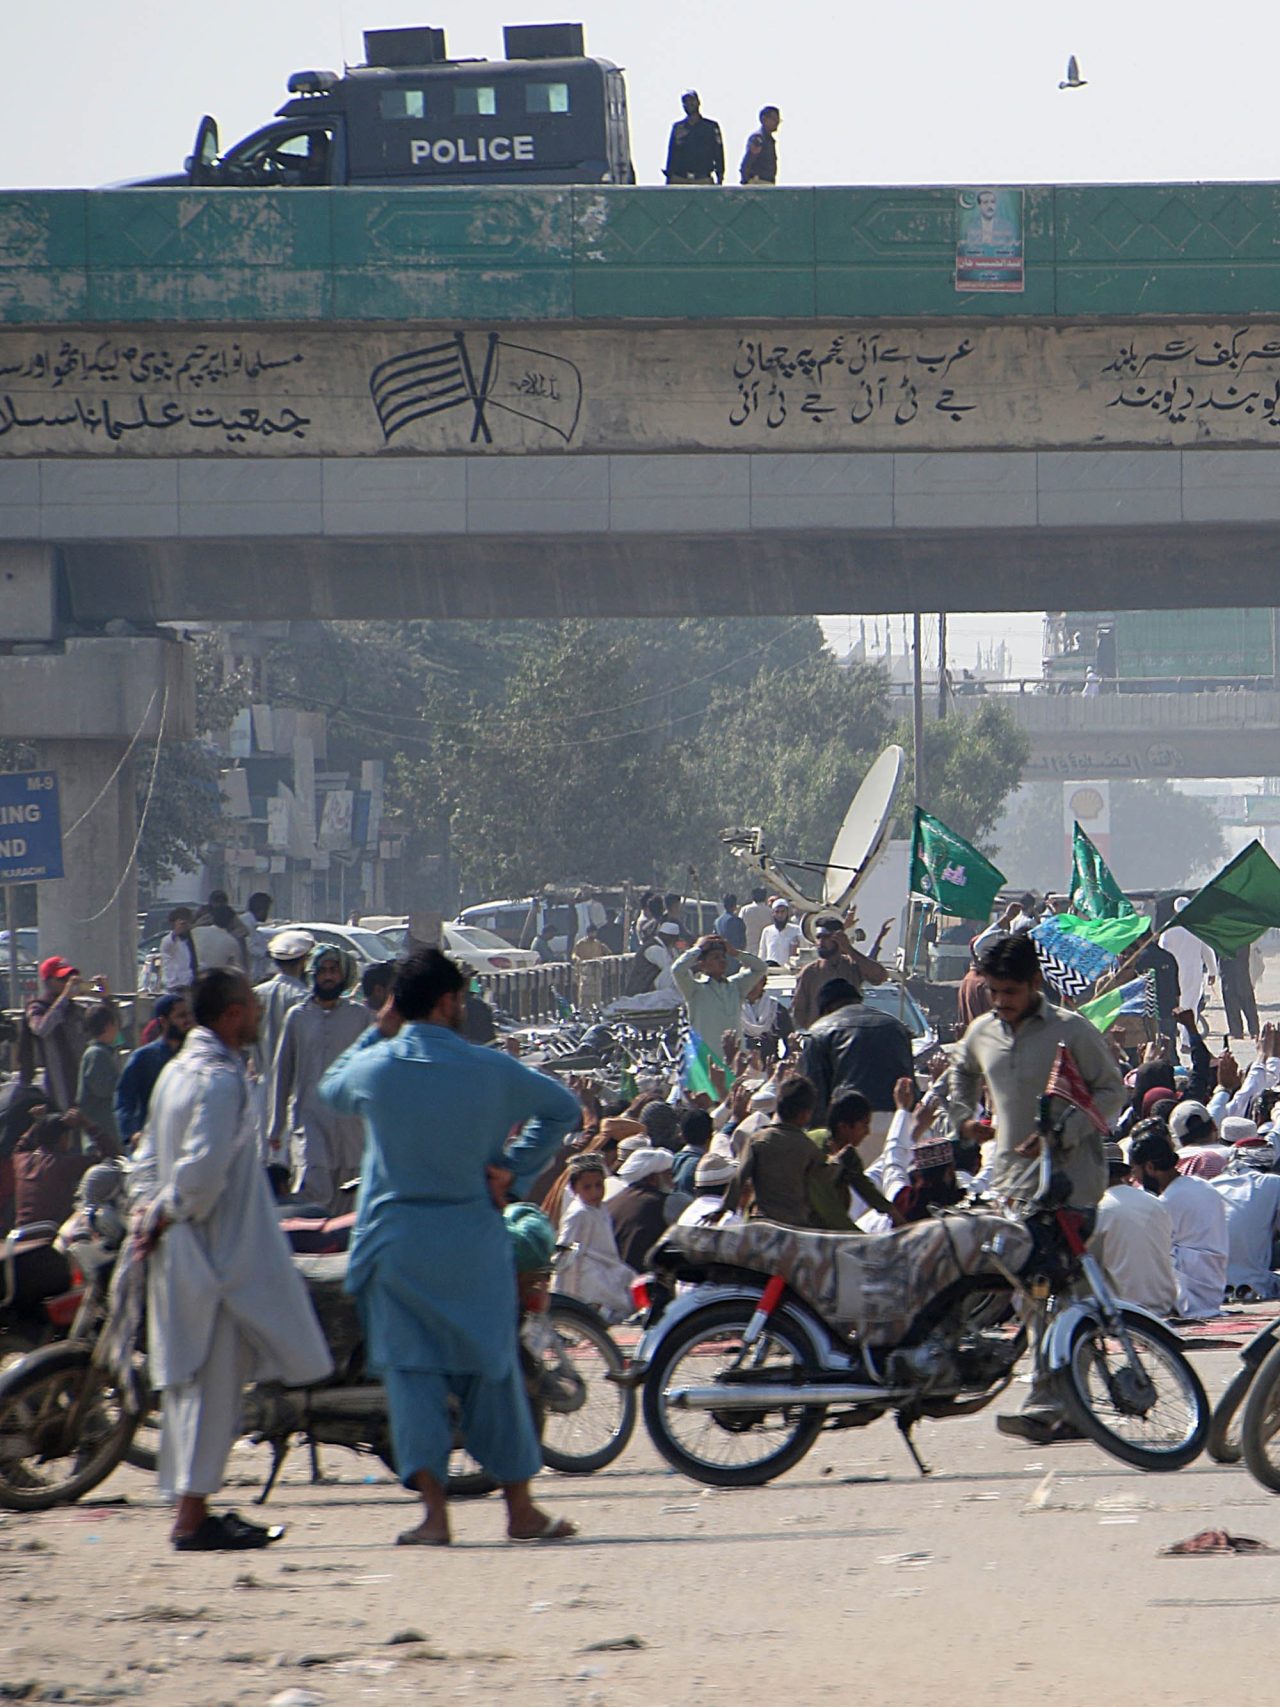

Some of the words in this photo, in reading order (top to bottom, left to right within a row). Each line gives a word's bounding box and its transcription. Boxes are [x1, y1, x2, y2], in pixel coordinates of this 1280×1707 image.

[411, 136, 534, 164] POLICE
[879, 347, 912, 362] سے
[915, 338, 976, 380] عرب
[1195, 326, 1250, 369] بکف
[729, 379, 761, 426] آئی
[767, 381, 787, 429] ٹی
[801, 393, 838, 423] جے
[852, 376, 887, 424] آئی
[895, 374, 920, 426] ٹی
[935, 389, 978, 422] جے
[1106, 377, 1195, 425] دیوبند
[189, 408, 312, 443] جمعیت
[27, 776, 54, 791] M-9
[0, 803, 41, 825] ING
[0, 838, 27, 858] ND
